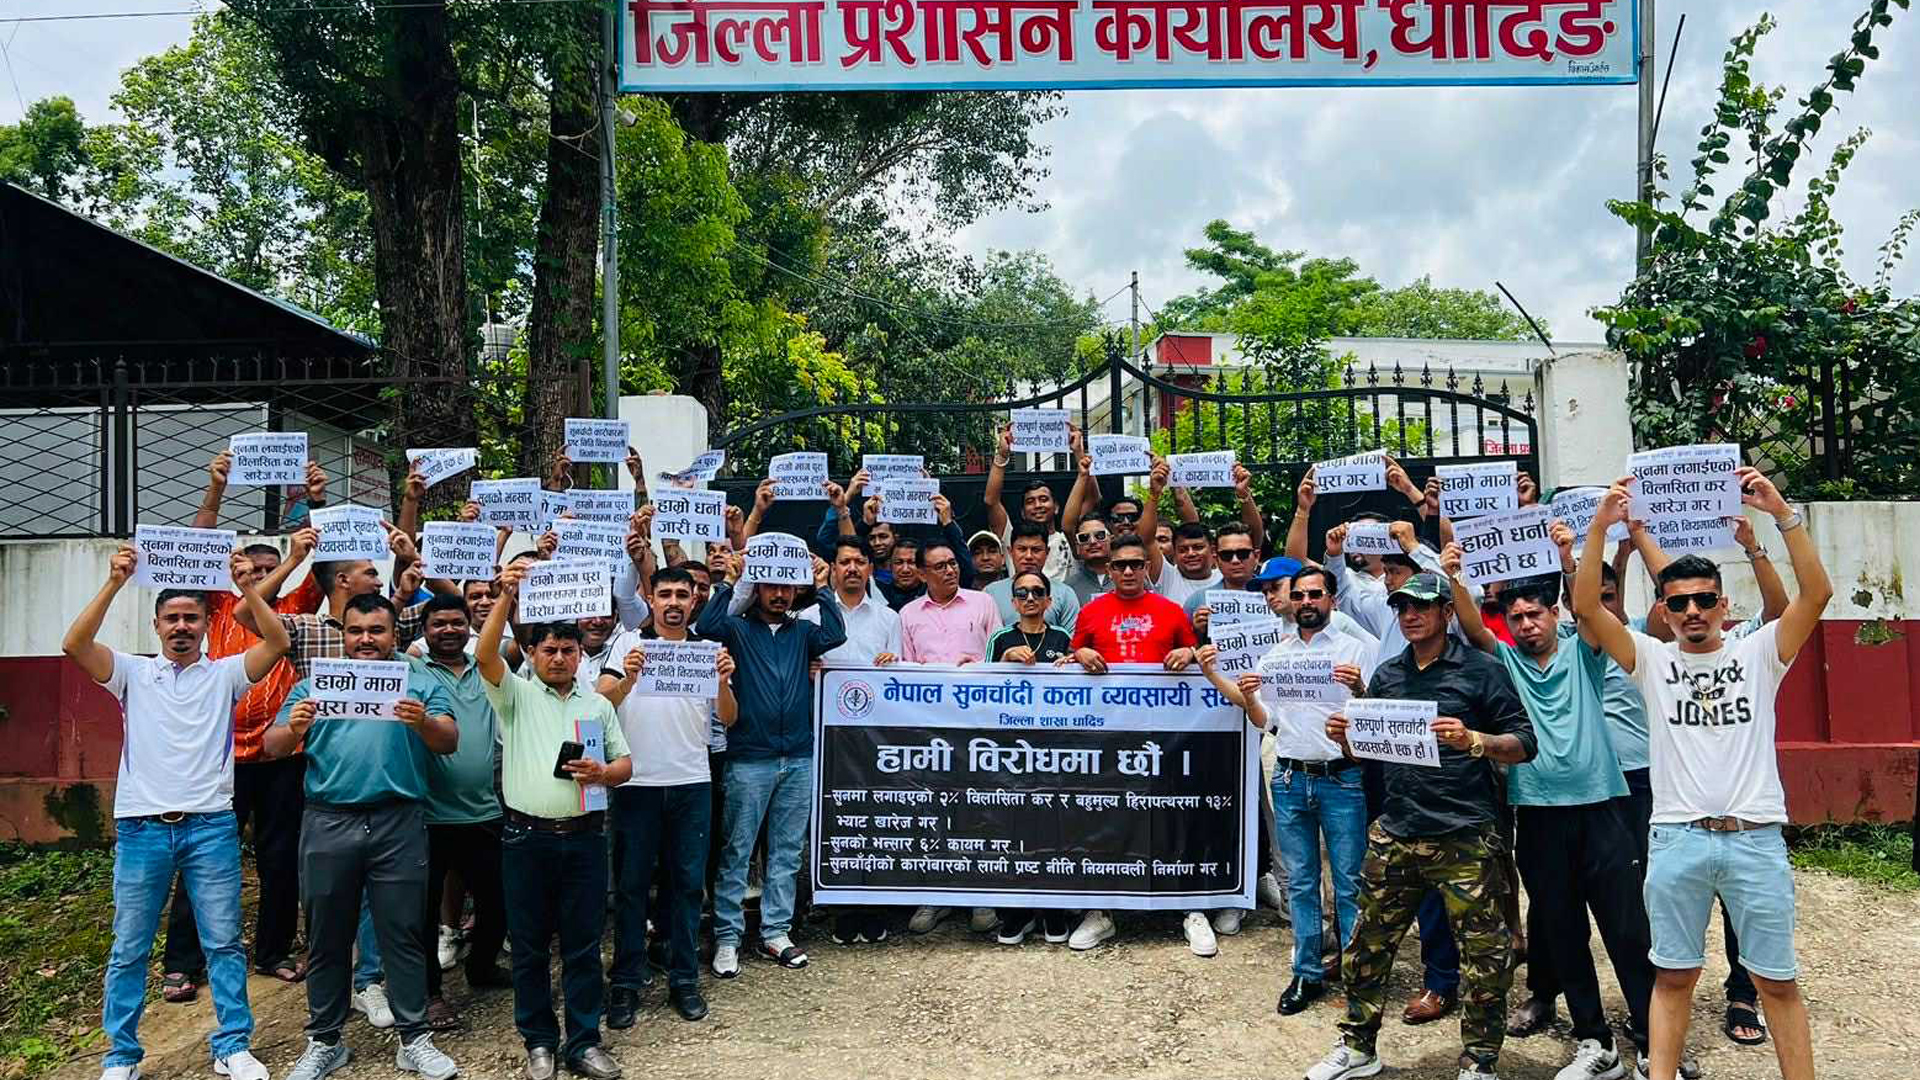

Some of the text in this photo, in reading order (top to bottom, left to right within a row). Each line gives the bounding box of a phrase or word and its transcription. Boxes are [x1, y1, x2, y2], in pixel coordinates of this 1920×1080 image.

[838, 0, 1078, 68] प्रशासन
[1632, 465, 1668, 480] सुनमा
[1440, 473, 1513, 492] हाम्रो माग
[1642, 479, 1729, 496] विलासिता कर
[657, 497, 690, 515] हाम्रो
[1444, 498, 1470, 516] पुरा
[1475, 496, 1499, 510] गर
[1649, 498, 1687, 514] खारेज
[1691, 499, 1712, 512] गर
[657, 518, 690, 536] जारी
[695, 523, 711, 537] छ
[140, 539, 174, 553] सुनमा
[747, 541, 809, 559] हाम्रो माग
[1460, 527, 1504, 554] हाम्रो
[148, 553, 224, 570] विलासिता कर
[1467, 552, 1512, 579] जारी
[1517, 552, 1538, 569] छ
[151, 570, 186, 584] खारेज
[190, 574, 208, 585] गर
[748, 565, 772, 580] पुरा
[777, 566, 798, 579] गर
[526, 603, 555, 618] विरोध
[558, 602, 582, 615] जारी
[1215, 632, 1247, 652] हाम्रो
[1220, 652, 1253, 672] जारी
[315, 671, 403, 693] हाम्रो माग
[884, 677, 943, 704] नेपाल
[952, 679, 1034, 710] सुनचाँदी
[1043, 686, 1093, 707] कला
[1101, 682, 1192, 708] व्यवसायी
[316, 700, 384, 717] पुरा गर
[1669, 697, 1752, 727] JONES
[999, 713, 1035, 727] जिल्ला
[1040, 716, 1068, 727] शाखा
[876, 738, 954, 773] हामी
[968, 737, 1103, 774] विरोधमा
[873, 788, 934, 806] लगाइएको
[966, 787, 1026, 807] विलासिता
[1031, 793, 1054, 809] कर
[1060, 794, 1070, 809] र
[835, 814, 869, 829] भ्याट
[874, 812, 913, 832] खारेज
[918, 815, 939, 832] गर
[872, 836, 914, 852] भन्सार
[947, 838, 986, 852] कायम
[991, 839, 1012, 853] गर
[900, 856, 972, 874] कारोबारको
[977, 856, 1008, 873] लागी
[1014, 861, 1040, 876] प्रष्ट
[1046, 857, 1077, 875] नीति
[1082, 857, 1147, 877] नियमावली
[1152, 859, 1195, 876] निर्माण
[1200, 862, 1219, 877] गर
